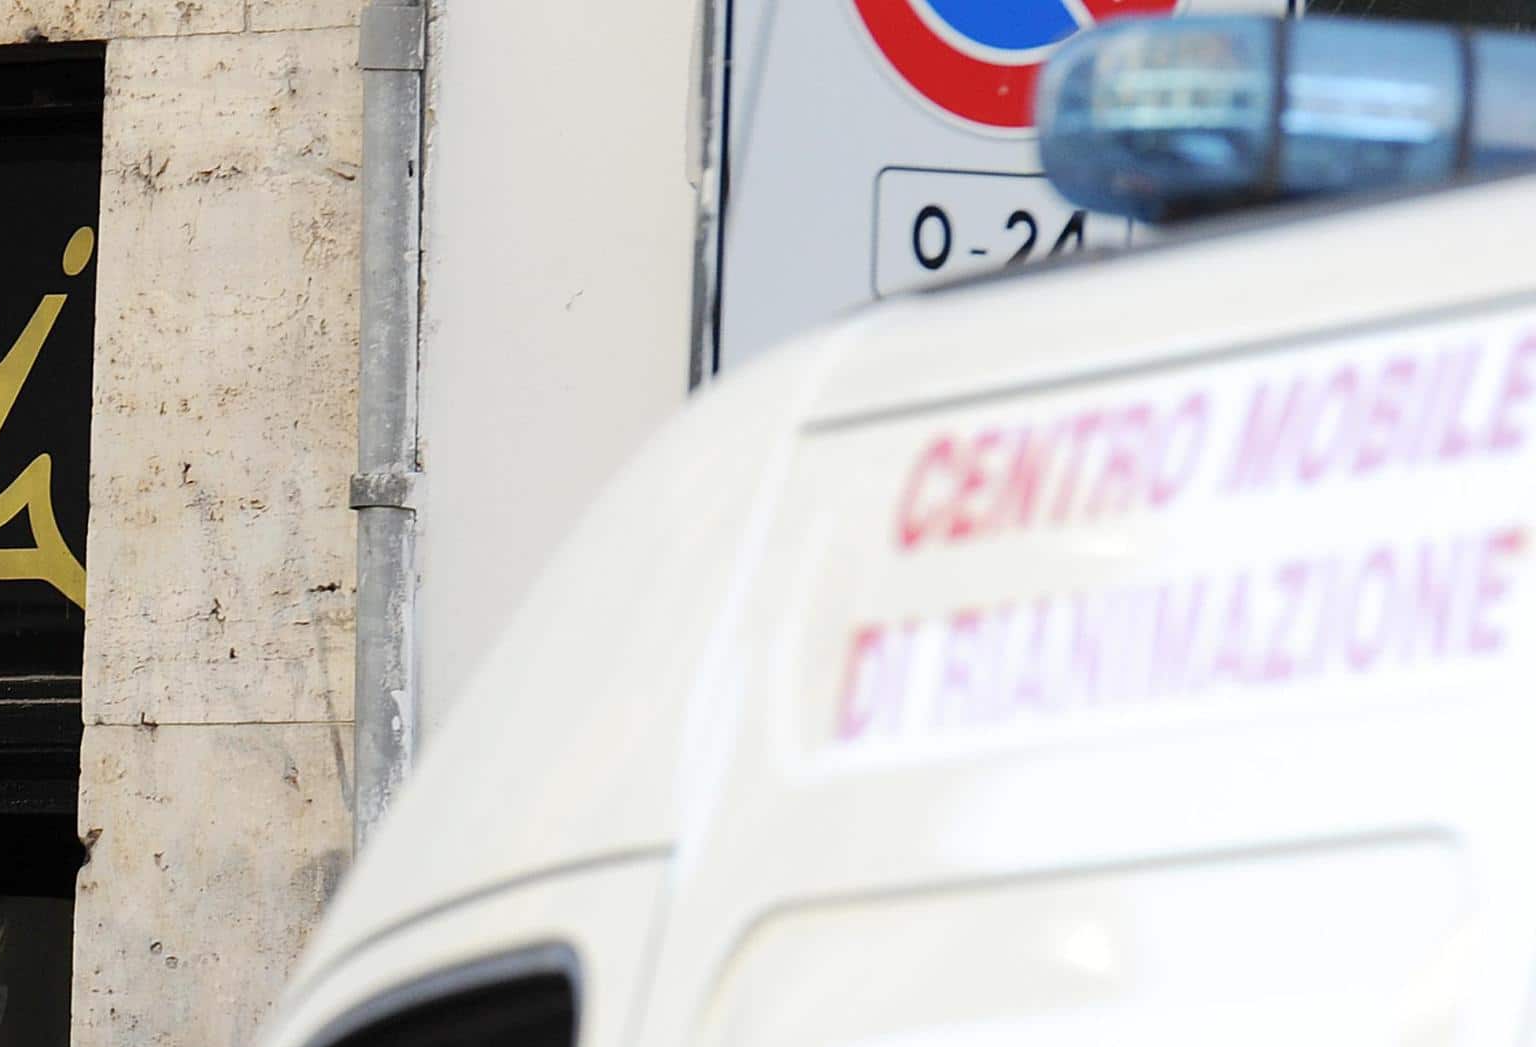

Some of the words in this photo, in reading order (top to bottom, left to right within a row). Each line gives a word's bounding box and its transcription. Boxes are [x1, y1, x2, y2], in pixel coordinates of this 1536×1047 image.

[892, 386, 1213, 556] CENTRO
[1220, 328, 1536, 496] MOBILE
[831, 612, 919, 744] DI
[930, 524, 1533, 732] RIANIMAZIONE
